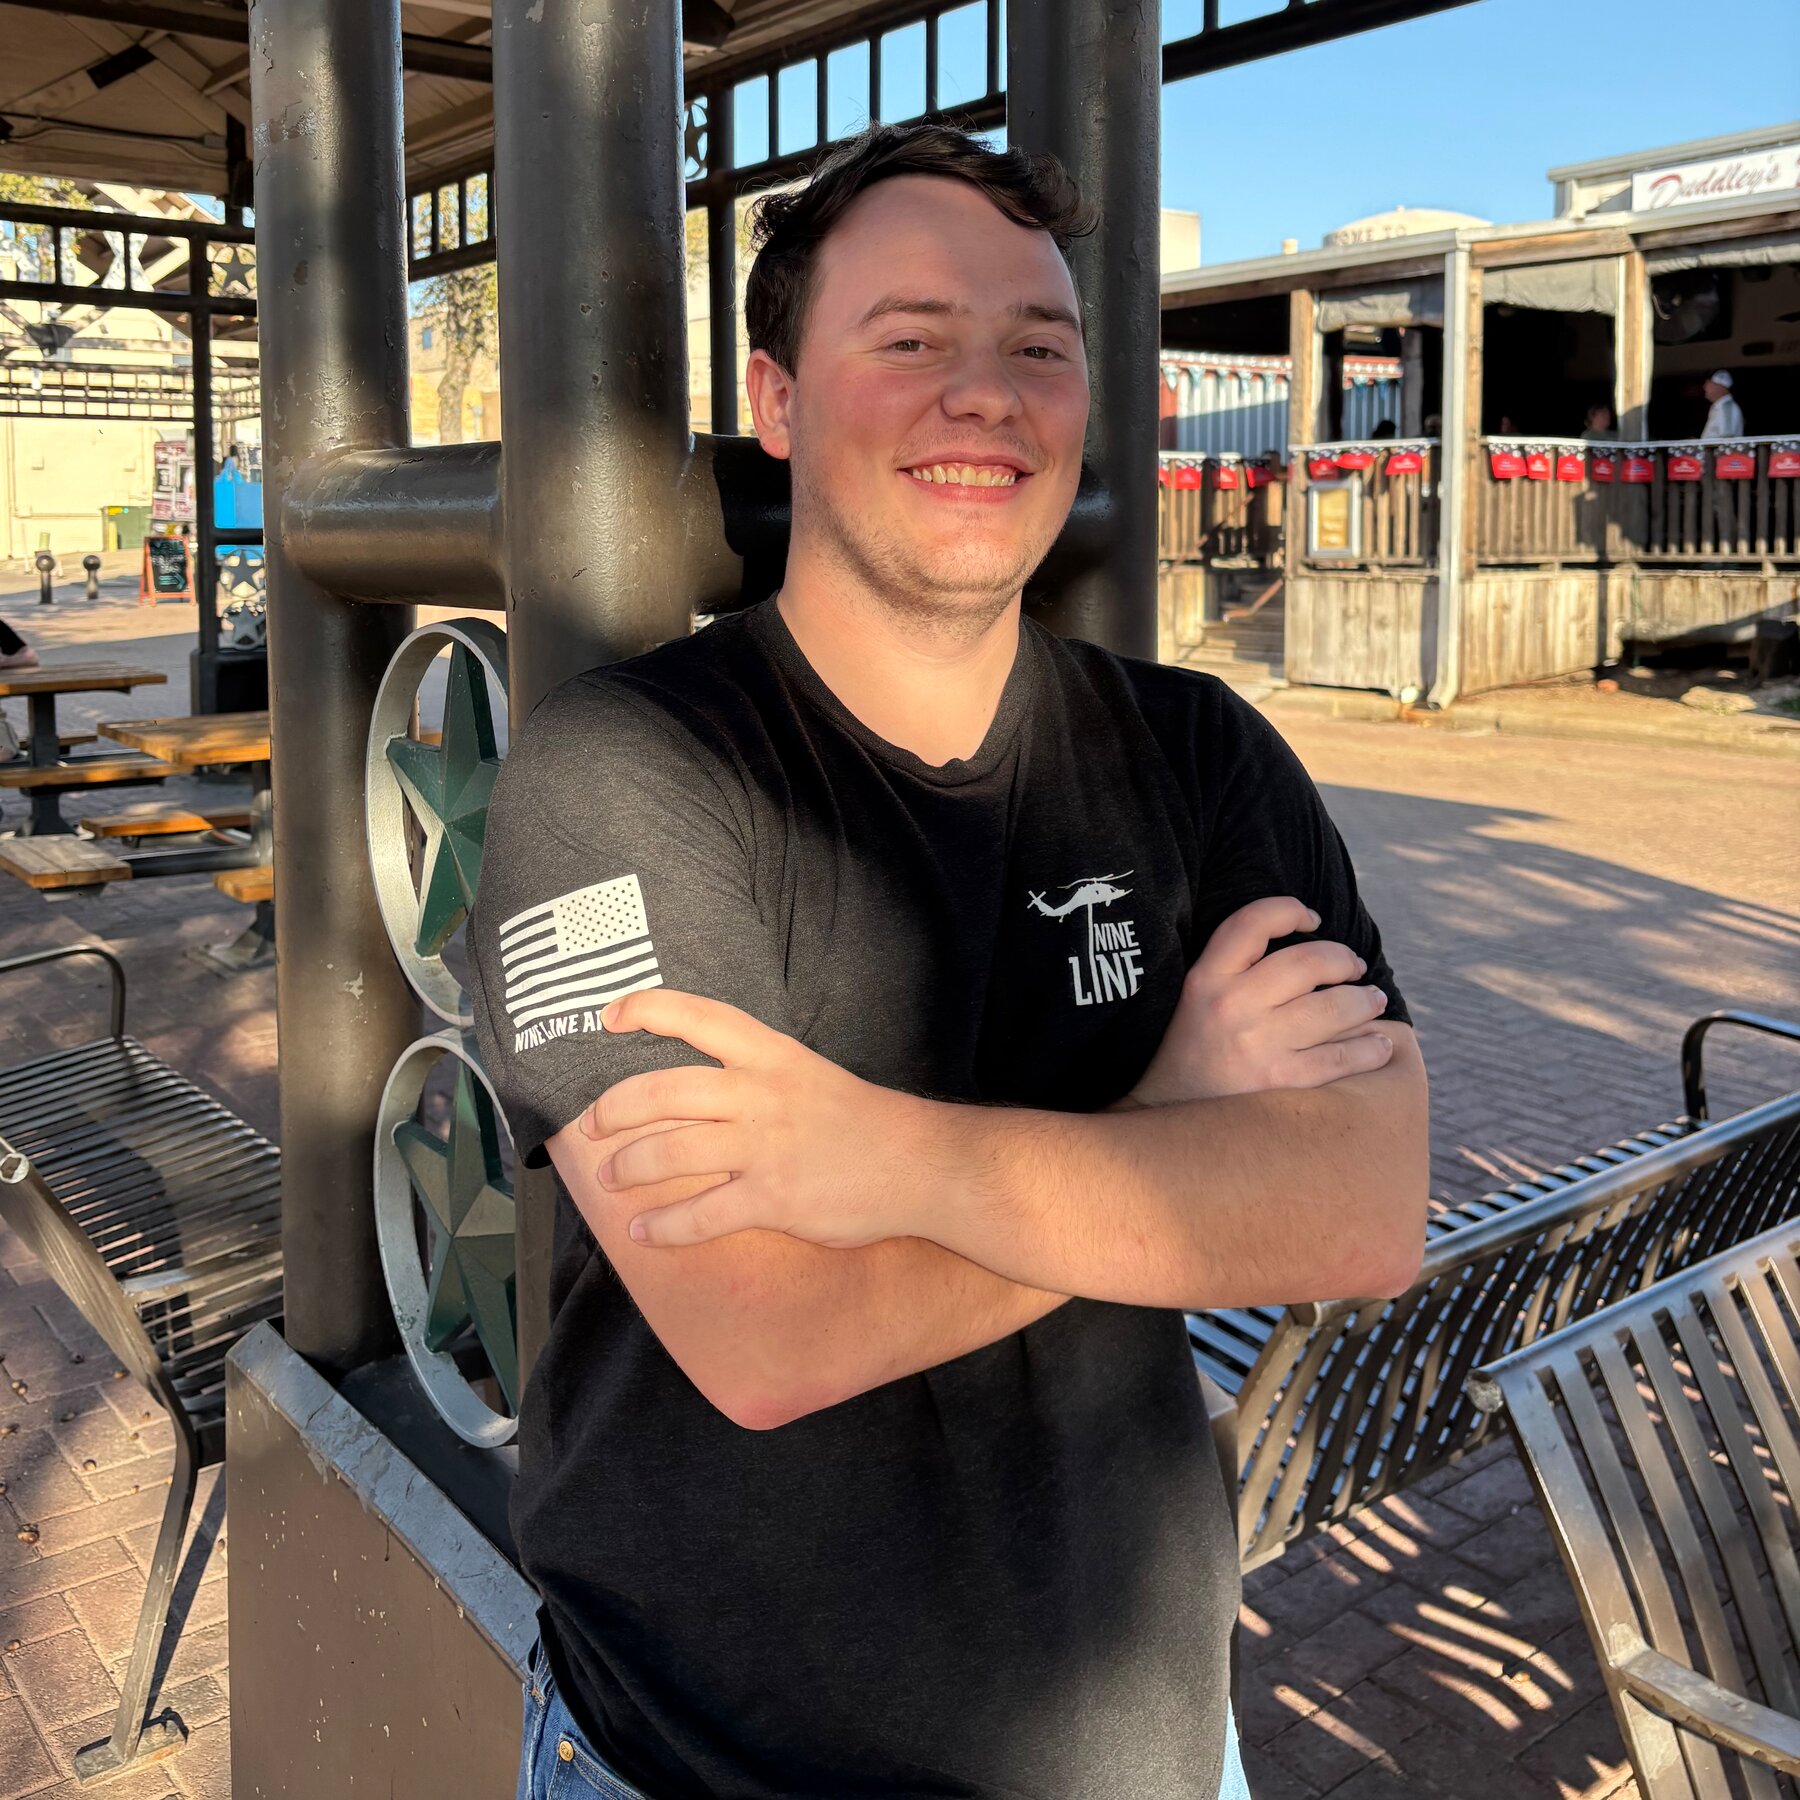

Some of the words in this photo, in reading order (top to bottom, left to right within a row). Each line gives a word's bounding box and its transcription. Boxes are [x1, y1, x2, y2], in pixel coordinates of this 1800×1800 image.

[1649, 155, 1779, 208] Duddley's
[1094, 921, 1139, 952] NINE
[515, 1024, 546, 1053] NINE
[539, 1013, 579, 1040] LINE
